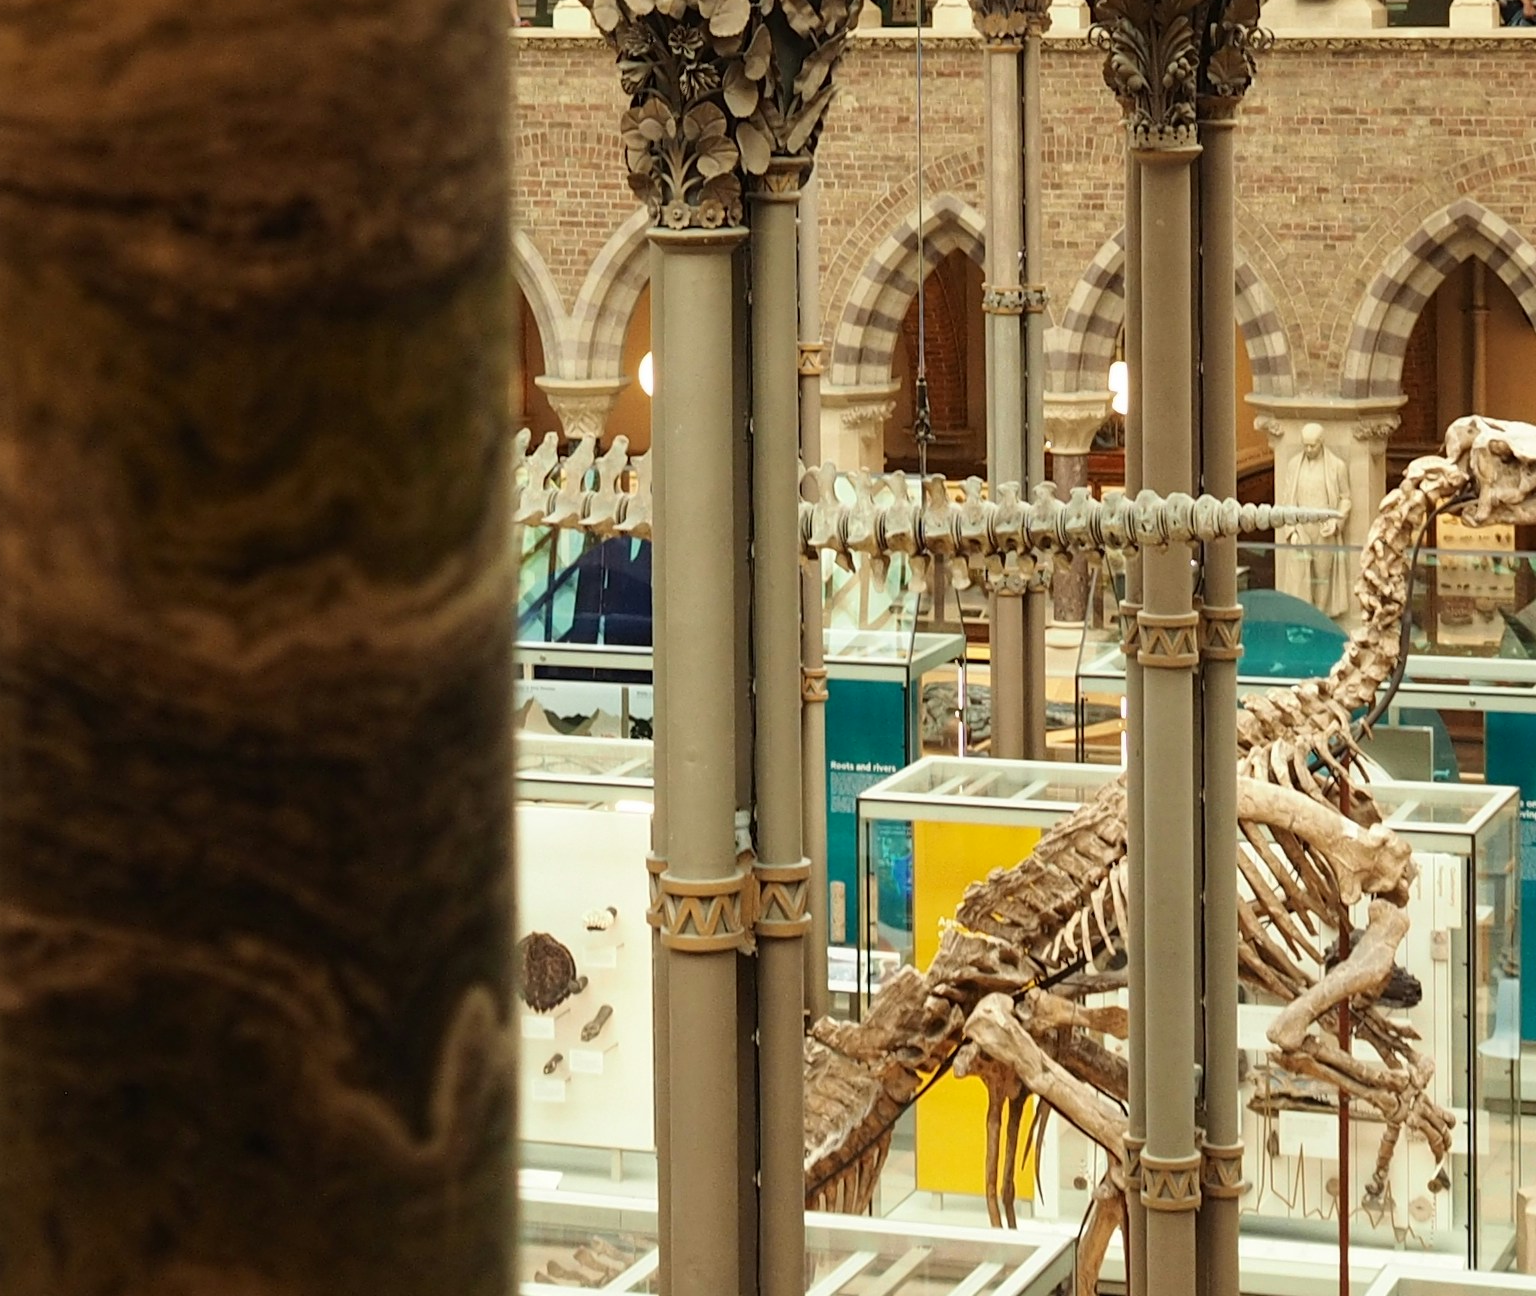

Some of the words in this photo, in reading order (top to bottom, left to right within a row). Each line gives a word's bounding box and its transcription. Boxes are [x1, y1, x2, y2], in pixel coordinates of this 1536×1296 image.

[831, 761, 855, 771] Roots
[856, 762, 872, 773] and
[873, 763, 897, 773] rivers
